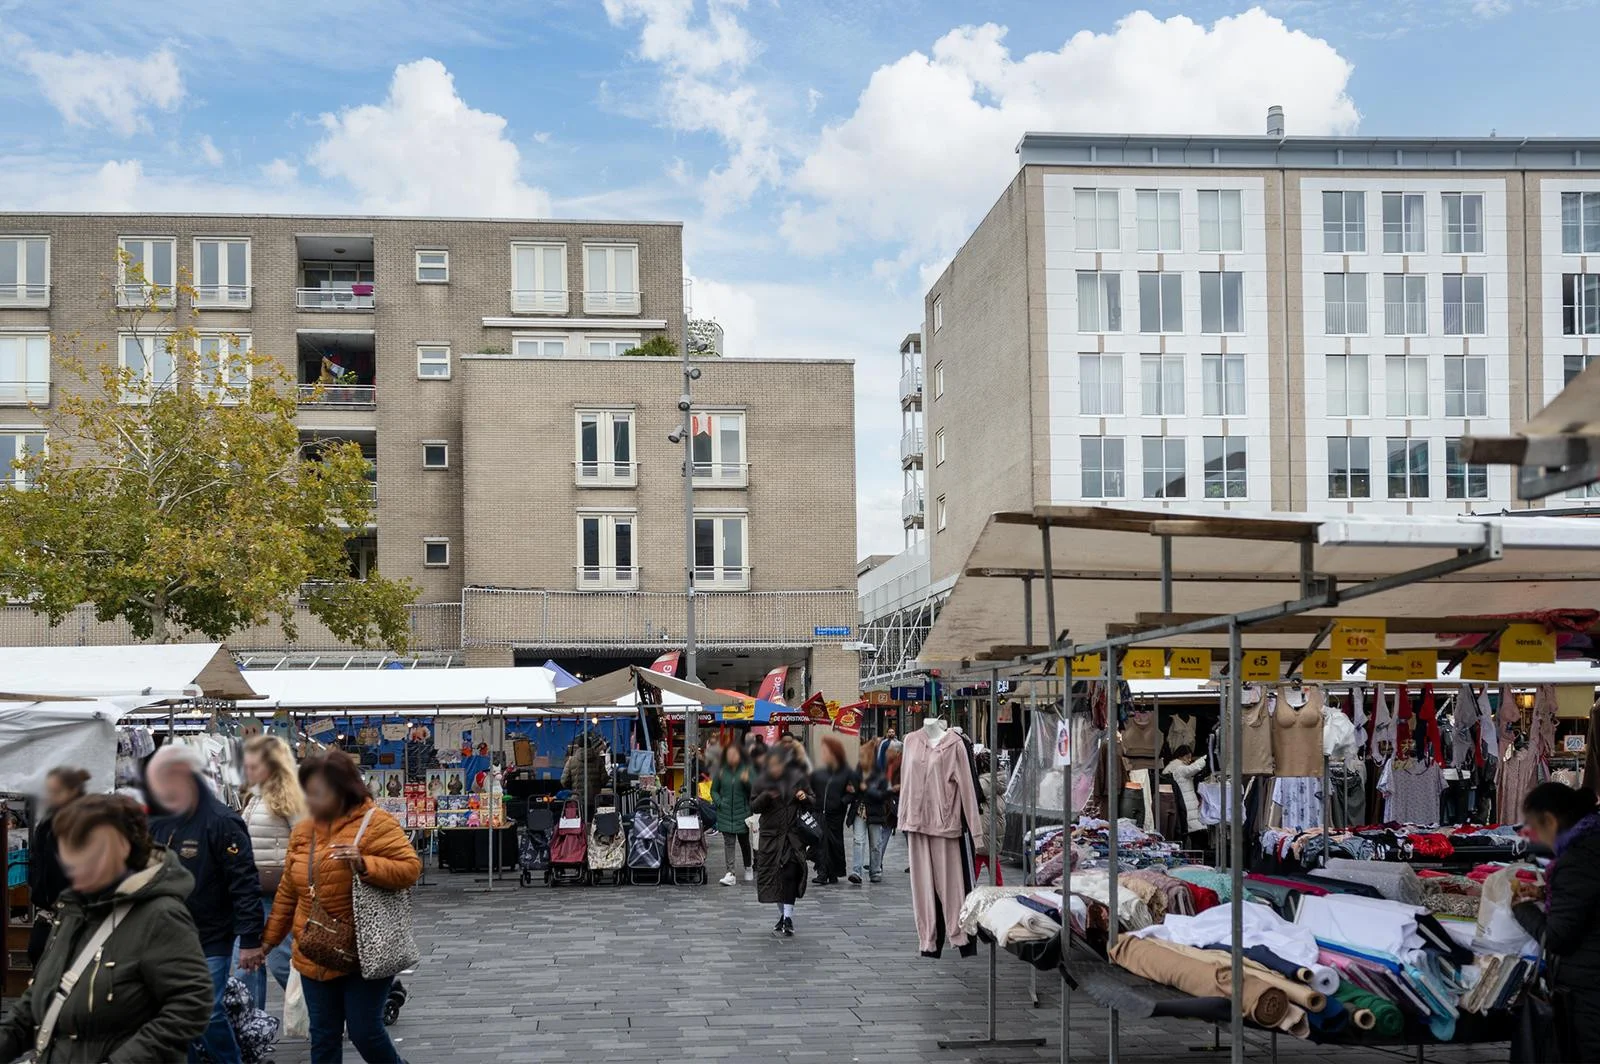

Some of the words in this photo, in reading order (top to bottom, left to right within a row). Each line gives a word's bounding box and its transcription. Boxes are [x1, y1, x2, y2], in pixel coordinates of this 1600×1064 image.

[1347, 636, 1368, 646] €10
[1132, 659, 1152, 669] €25
[1180, 656, 1201, 665] KANT
[1253, 655, 1269, 667] €5
